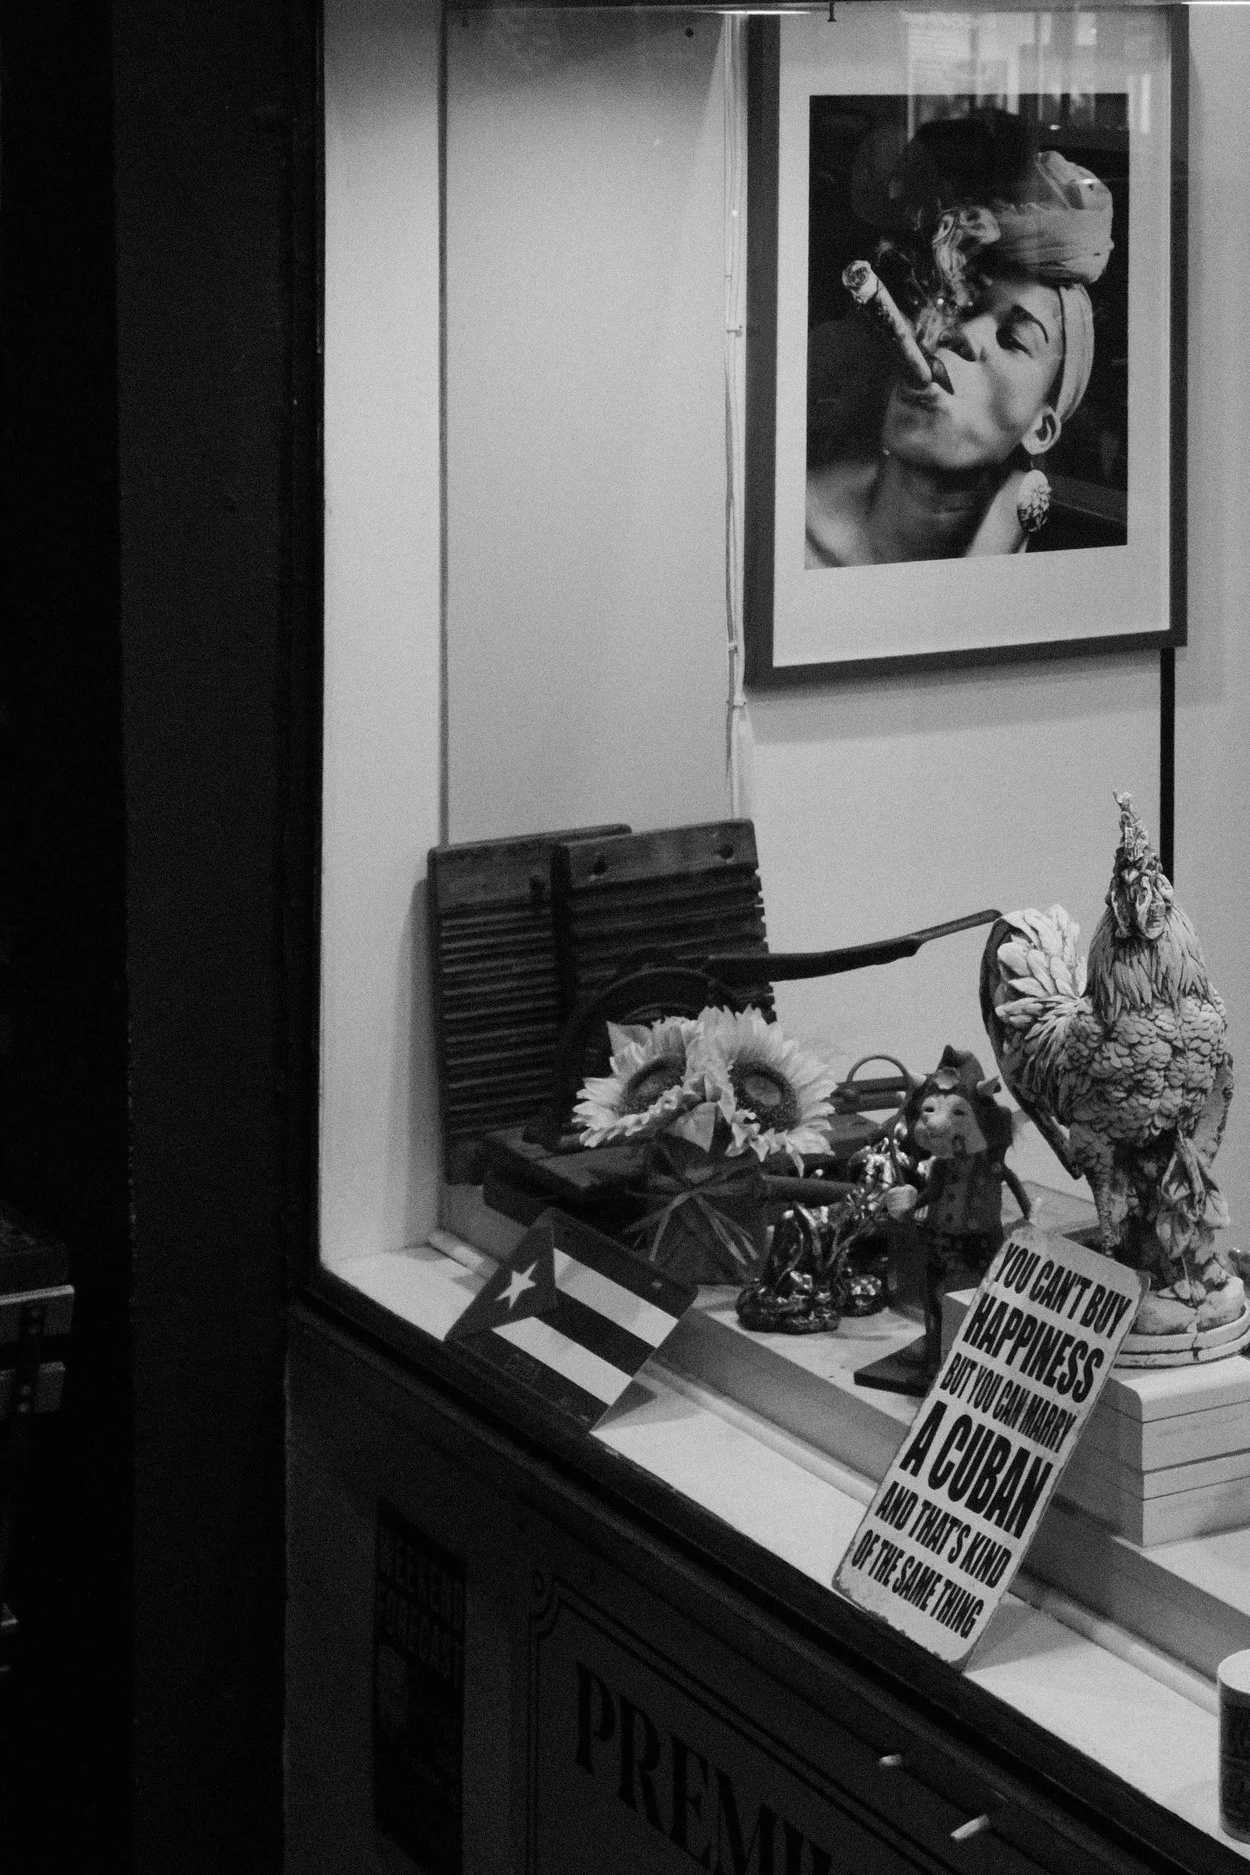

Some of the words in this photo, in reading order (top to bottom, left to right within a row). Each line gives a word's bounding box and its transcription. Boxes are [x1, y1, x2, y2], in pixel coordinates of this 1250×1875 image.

[994, 1242, 1041, 1294] YOU
[1029, 1259, 1093, 1320] CAN'T
[1080, 1283, 1132, 1339] BUY
[939, 1352, 978, 1398] BUT
[967, 1365, 1003, 1413] YOU
[992, 1380, 1031, 1429] CAN
[1018, 1394, 1077, 1453] MARRY
[962, 1293, 1104, 1403] HAPPINESS
[899, 1400, 948, 1477] A
[928, 1414, 1053, 1539] CUBAN
[852, 1529, 881, 1570] OF
[868, 1539, 905, 1588] THE
[892, 1556, 943, 1612] SAME
[930, 1579, 984, 1639] THING
[874, 1480, 919, 1530] AND
[908, 1499, 972, 1564] THAT'S
[959, 1531, 1012, 1588] KIND
[574, 1659, 833, 1875] PREM
